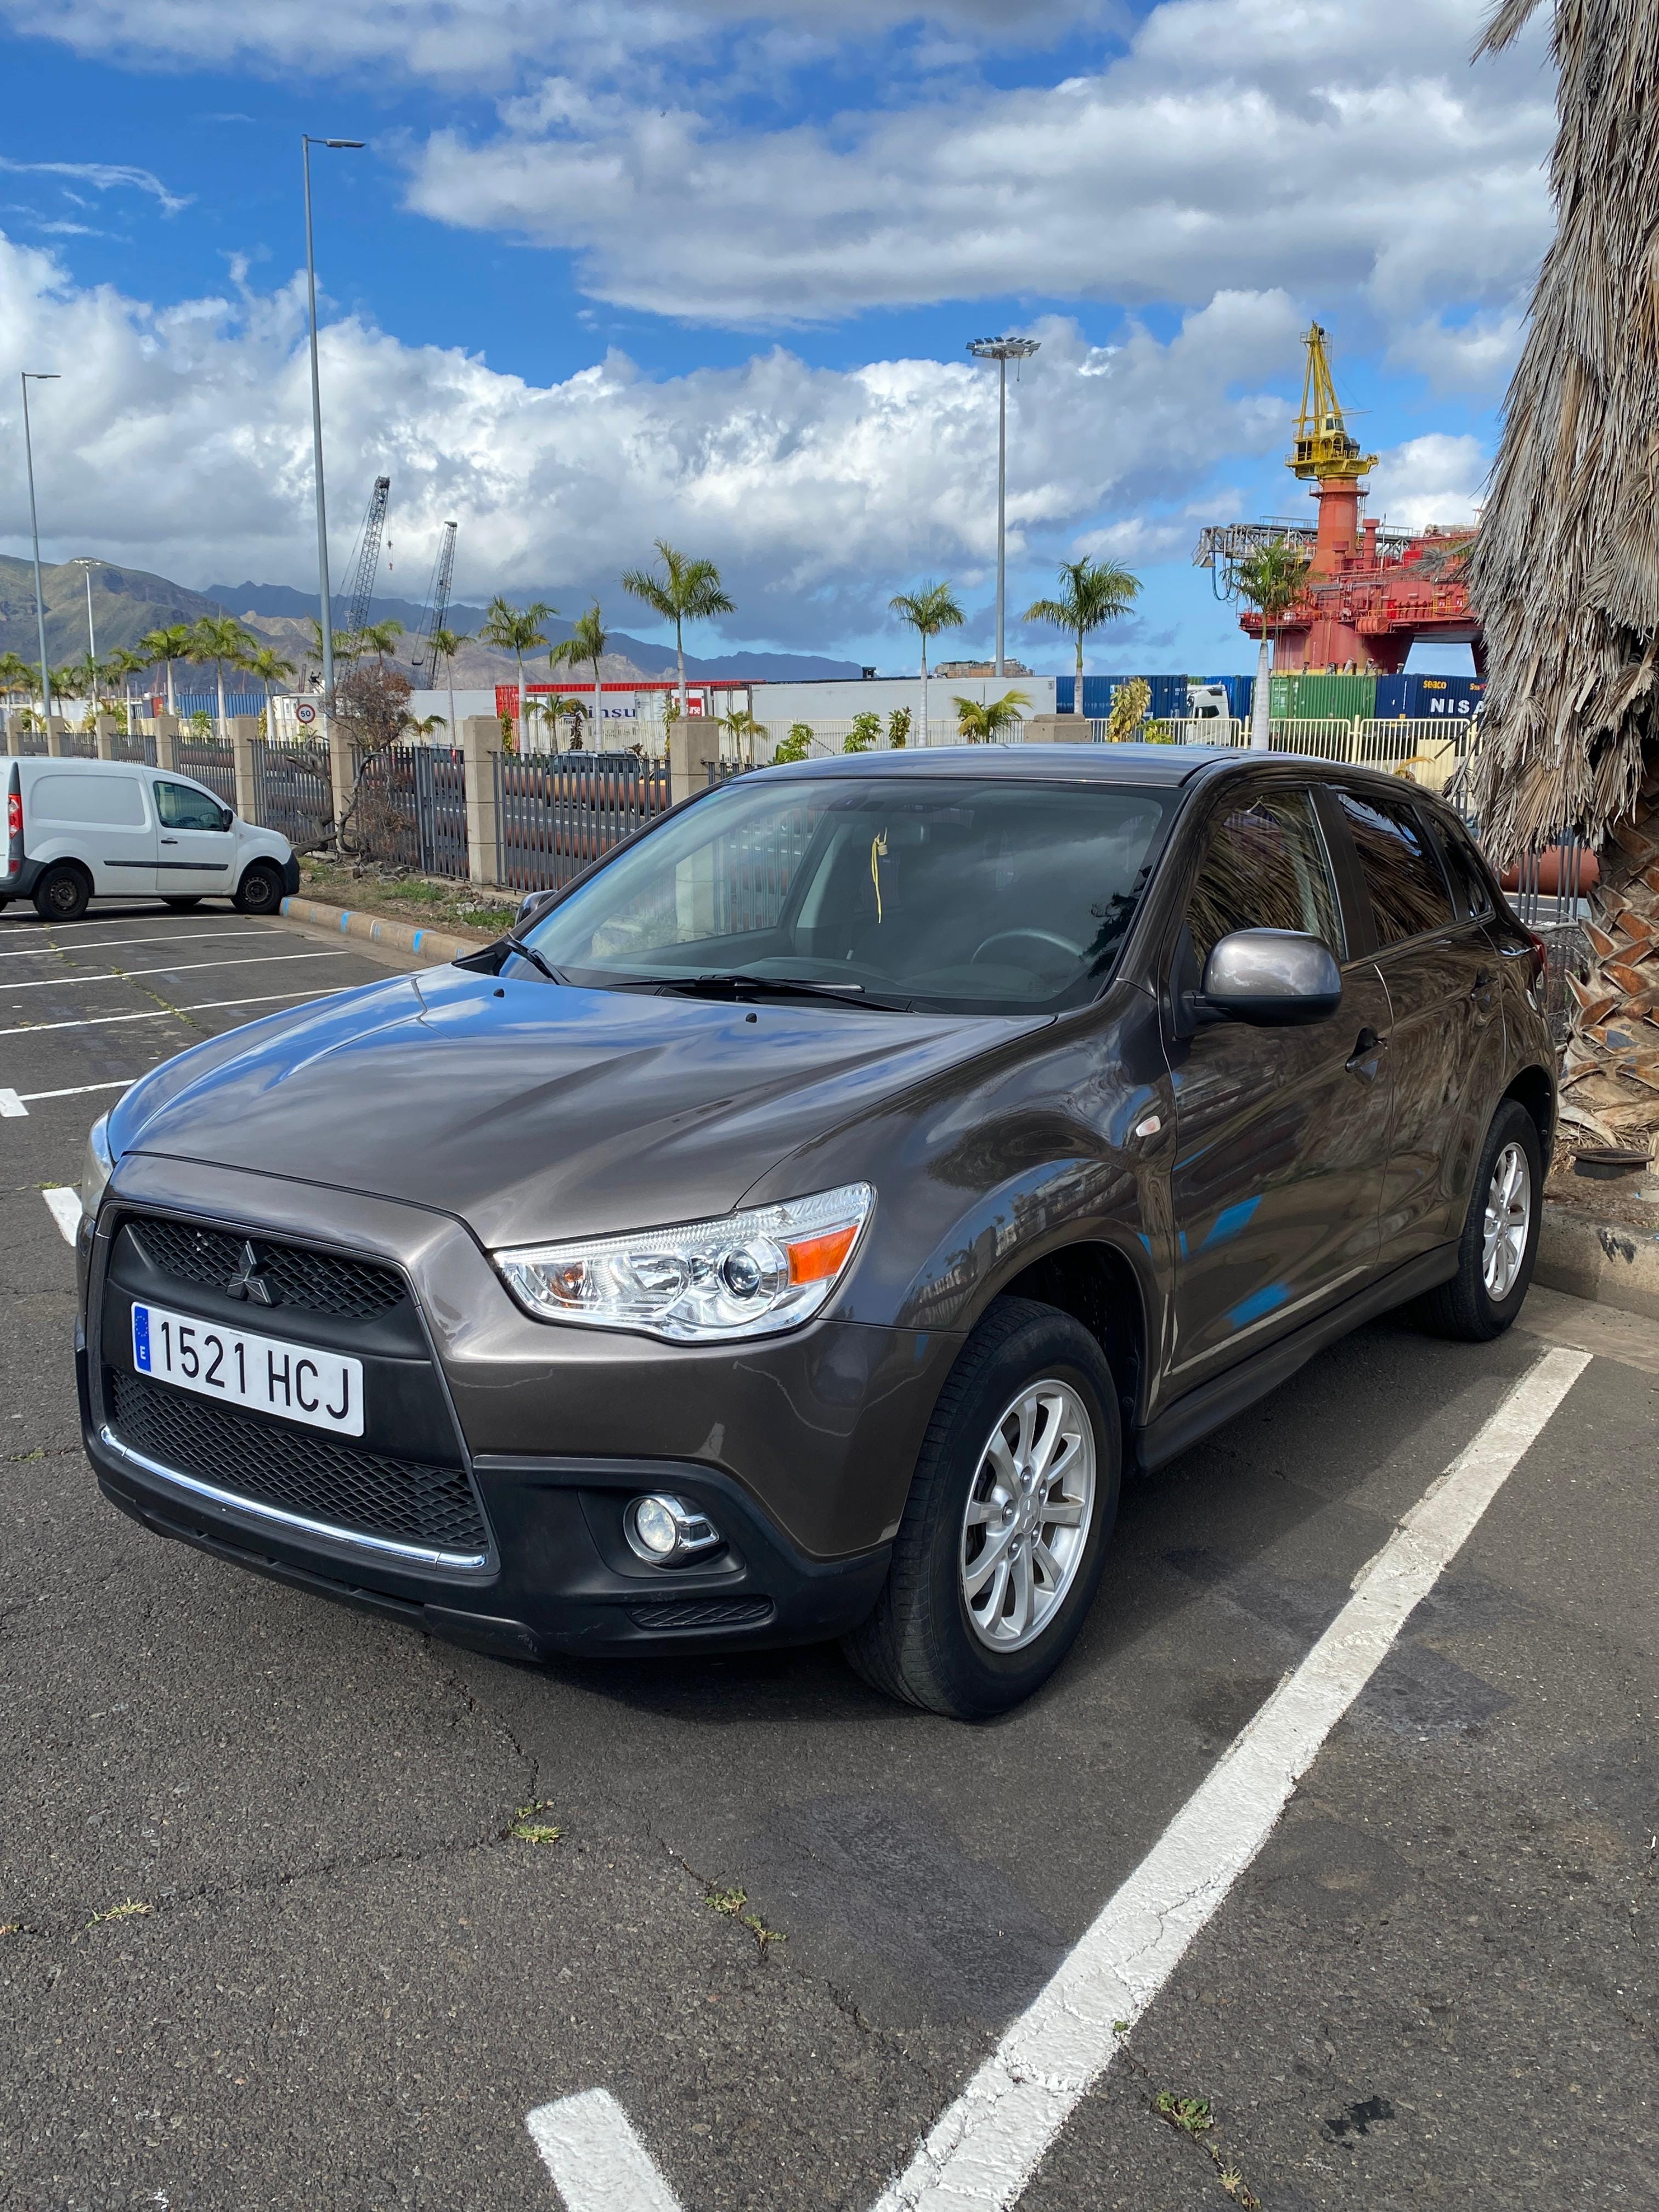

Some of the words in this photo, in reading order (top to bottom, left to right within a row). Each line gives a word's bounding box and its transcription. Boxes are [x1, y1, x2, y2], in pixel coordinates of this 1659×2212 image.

[1423, 680, 1447, 689] seaco
[139, 1346, 146, 1361] E
[161, 1321, 246, 1395] 1521
[267, 1350, 349, 1420] HCJ
